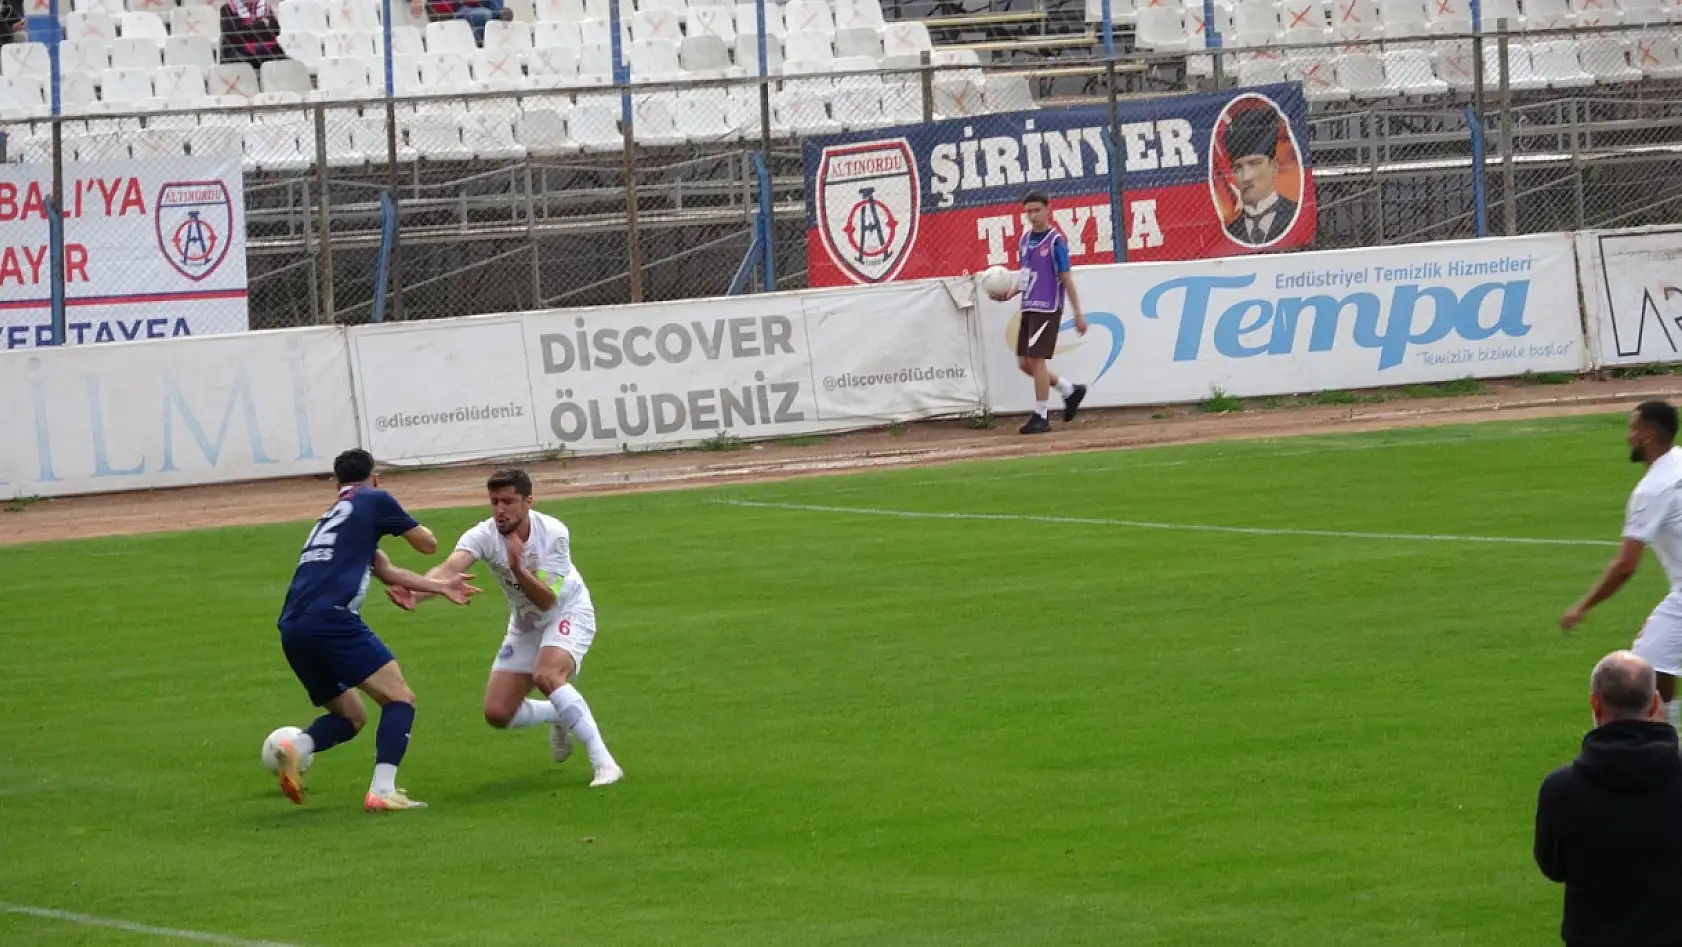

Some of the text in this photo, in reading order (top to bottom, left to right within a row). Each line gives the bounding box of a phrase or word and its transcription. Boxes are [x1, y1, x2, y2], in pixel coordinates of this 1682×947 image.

[831, 154, 904, 178] ALTINORDU
[0, 243, 89, 286] AYR
[1275, 254, 1532, 289] Endüstriyel Temizlik Hizmetleri
[1141, 273, 1532, 371] Tempa
[540, 315, 795, 375] DİSCOVER
[823, 363, 967, 392] @discoverölüdeniz
[0, 333, 325, 488] İLMİ
[375, 401, 525, 432] @discoverölüdeniz
[550, 370, 804, 442] ÖLÜDENİZ
[558, 619, 570, 636] 6
